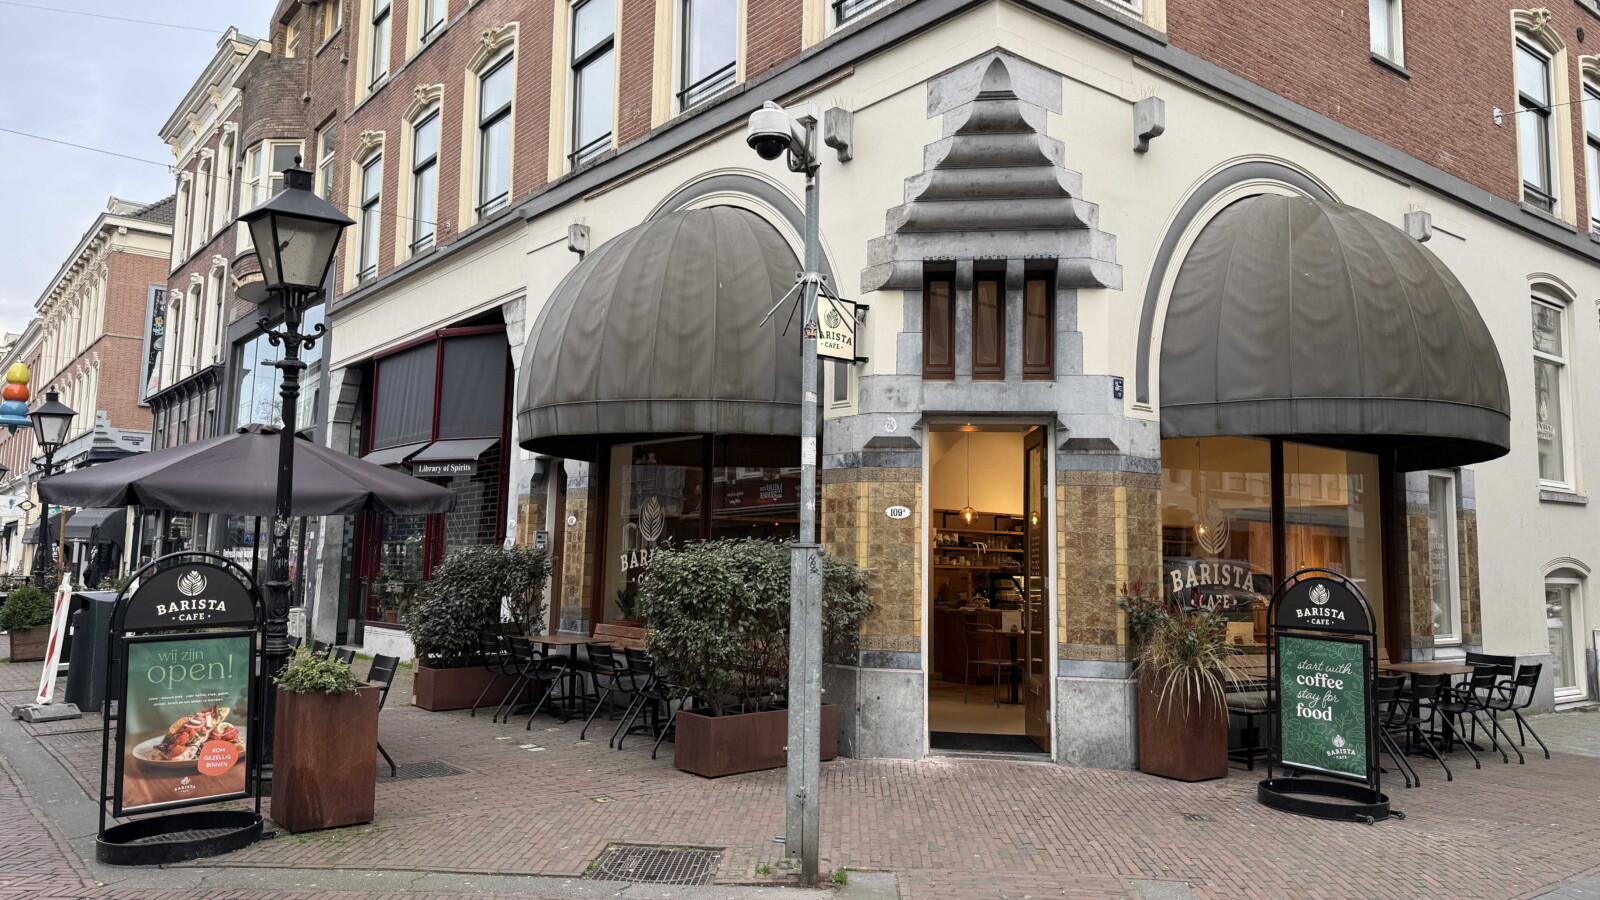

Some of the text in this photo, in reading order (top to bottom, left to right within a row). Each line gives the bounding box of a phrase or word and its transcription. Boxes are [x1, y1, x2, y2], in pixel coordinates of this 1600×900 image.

[818, 330, 852, 346] ARISTA
[824, 341, 840, 350] CAFE
[418, 463, 471, 474] Library of Spirits
[1170, 563, 1254, 593] BARISTA
[156, 599, 226, 616] BARISTA
[1199, 594, 1230, 609] CAFE
[178, 612, 205, 621] CAFE
[1296, 607, 1346, 620] BARISTA
[158, 648, 204, 663] wij zijn
[147, 653, 233, 690] open!
[1297, 659, 1352, 675] start with
[1296, 672, 1344, 690] coffee
[1296, 688, 1339, 709] stay for
[1296, 702, 1333, 721] food
[1326, 748, 1356, 757] BARISTA
[174, 784, 196, 792] BARISTA
